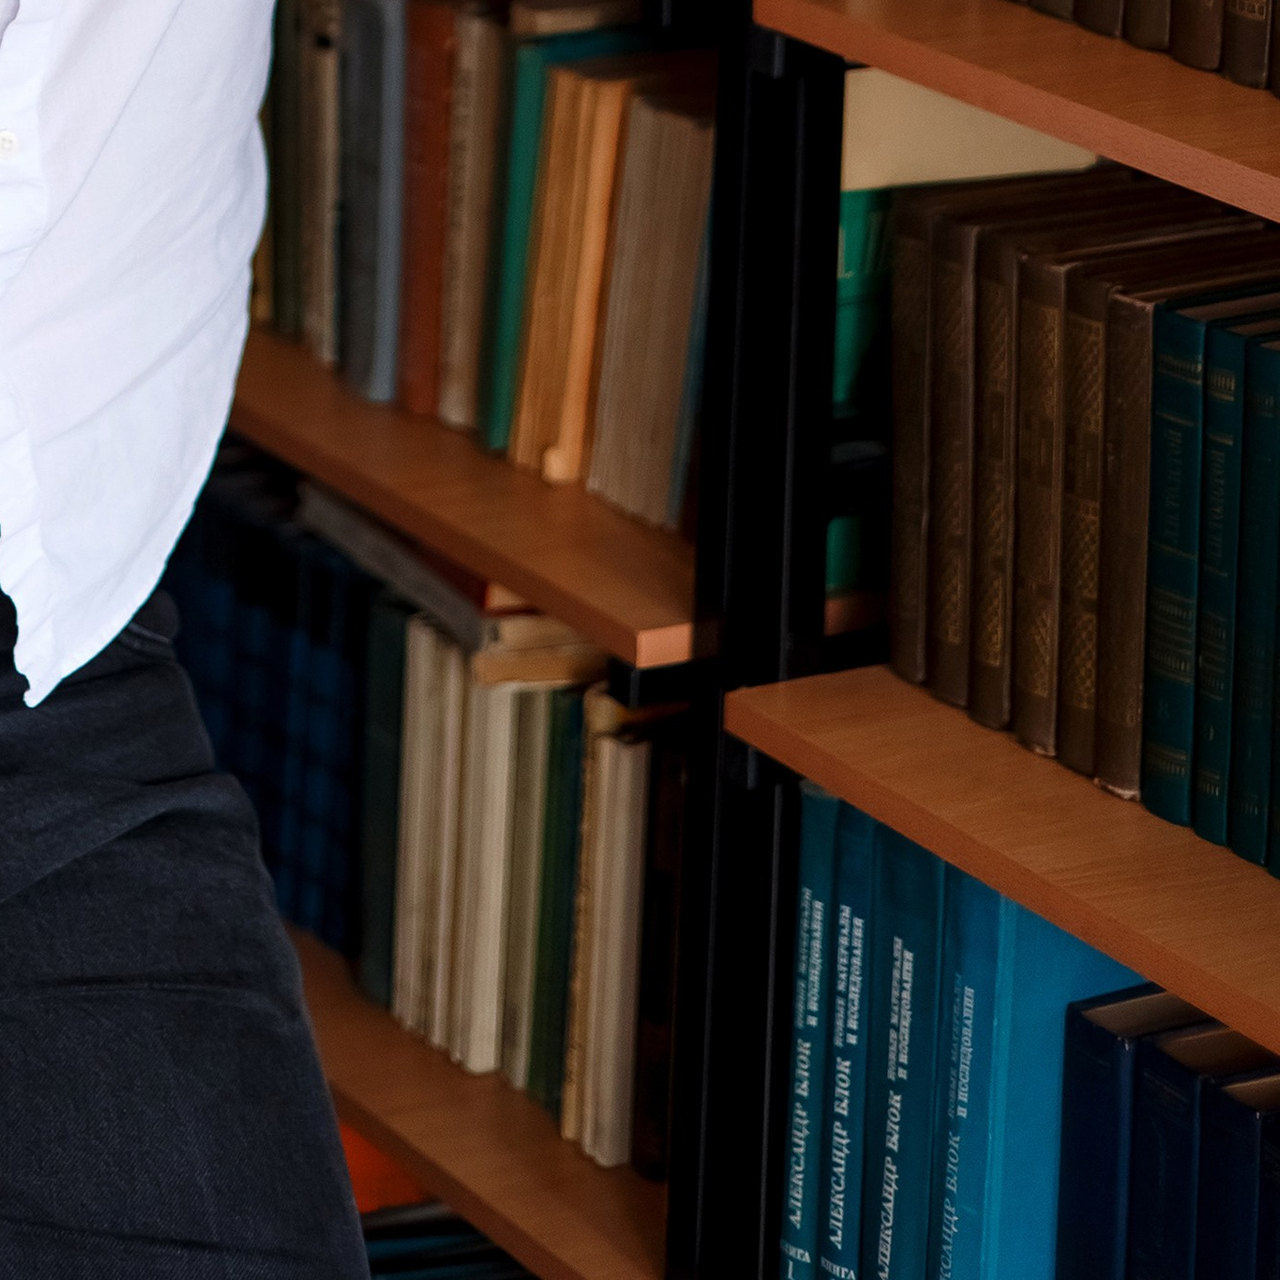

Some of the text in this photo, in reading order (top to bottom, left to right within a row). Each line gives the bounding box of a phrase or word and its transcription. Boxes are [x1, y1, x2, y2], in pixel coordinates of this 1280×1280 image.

[788, 1038, 812, 1230] АЛЕКСАНДР БЛОК
[829, 1057, 852, 1250] АЛЕКСАНДР БЛОК
[886, 1090, 902, 1153] БЛОК
[939, 1131, 961, 1280] КСАНДР БЛОК
